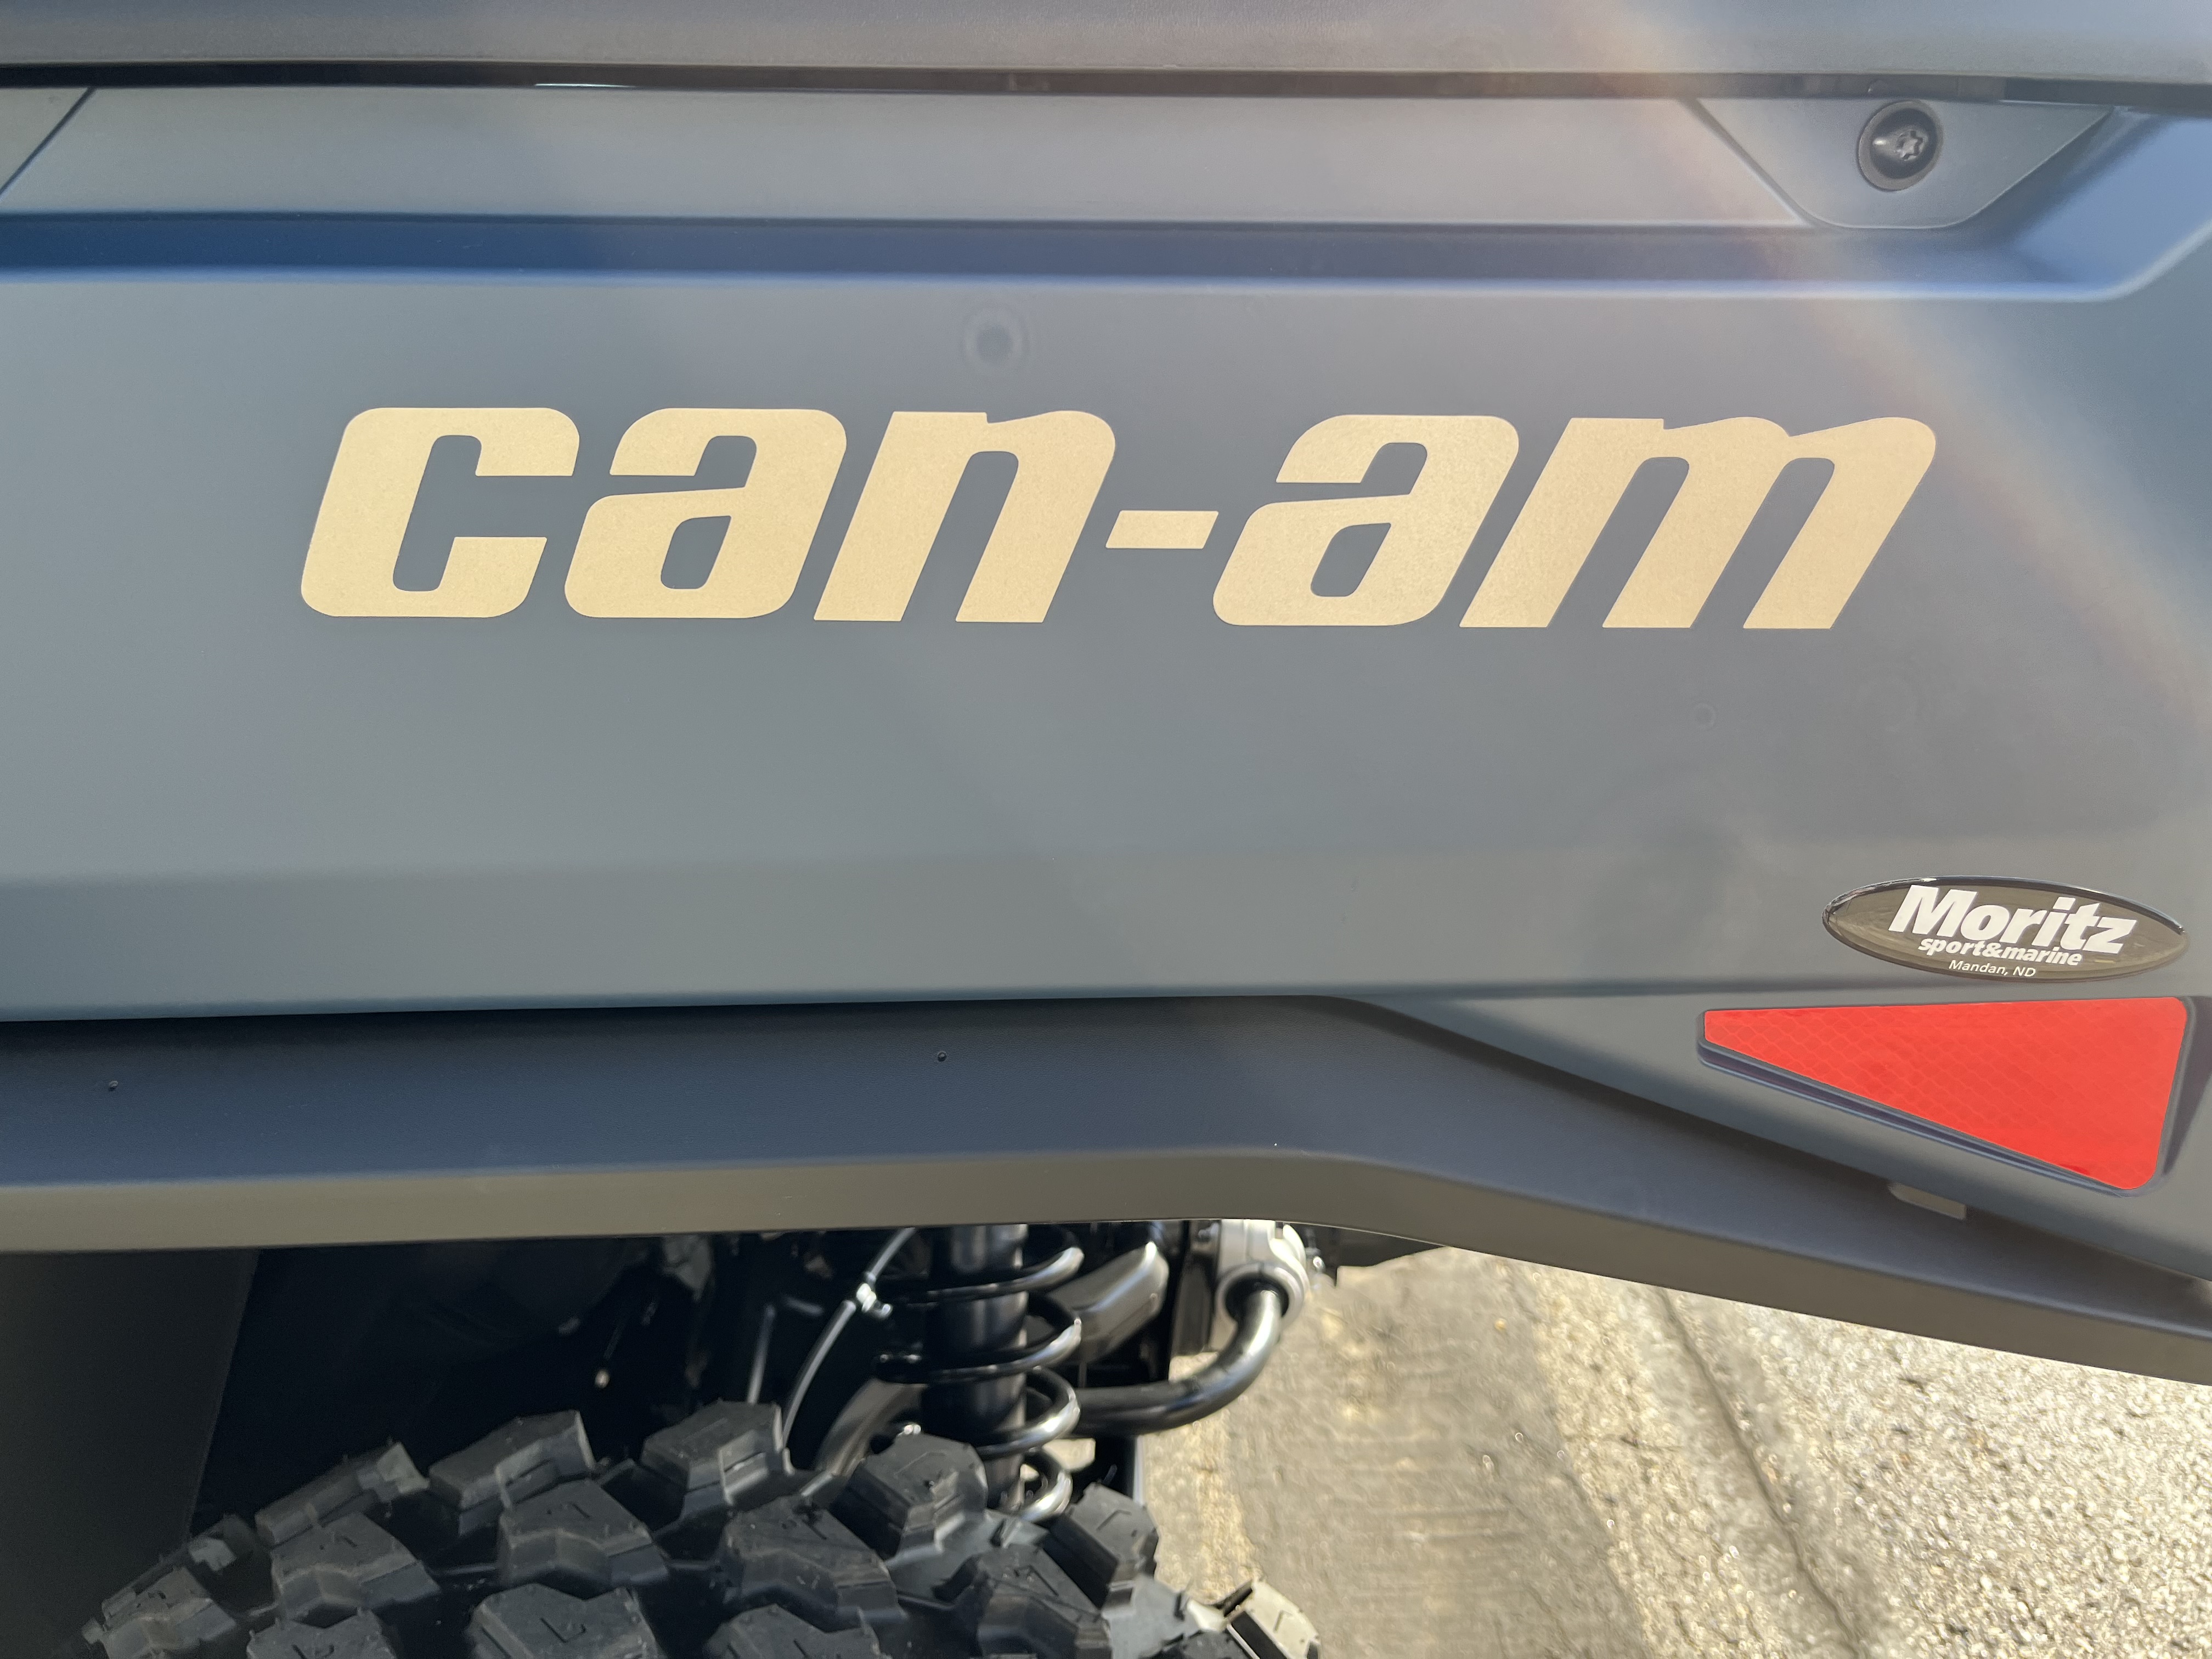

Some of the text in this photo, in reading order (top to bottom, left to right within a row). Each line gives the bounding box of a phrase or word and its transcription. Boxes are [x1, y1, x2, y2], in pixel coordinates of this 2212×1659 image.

[302, 408, 1937, 629] can-am
[1888, 884, 2137, 954] Moritz
[1918, 937, 2083, 966] sport&marine
[1948, 960, 2036, 978] Mandan, ND
